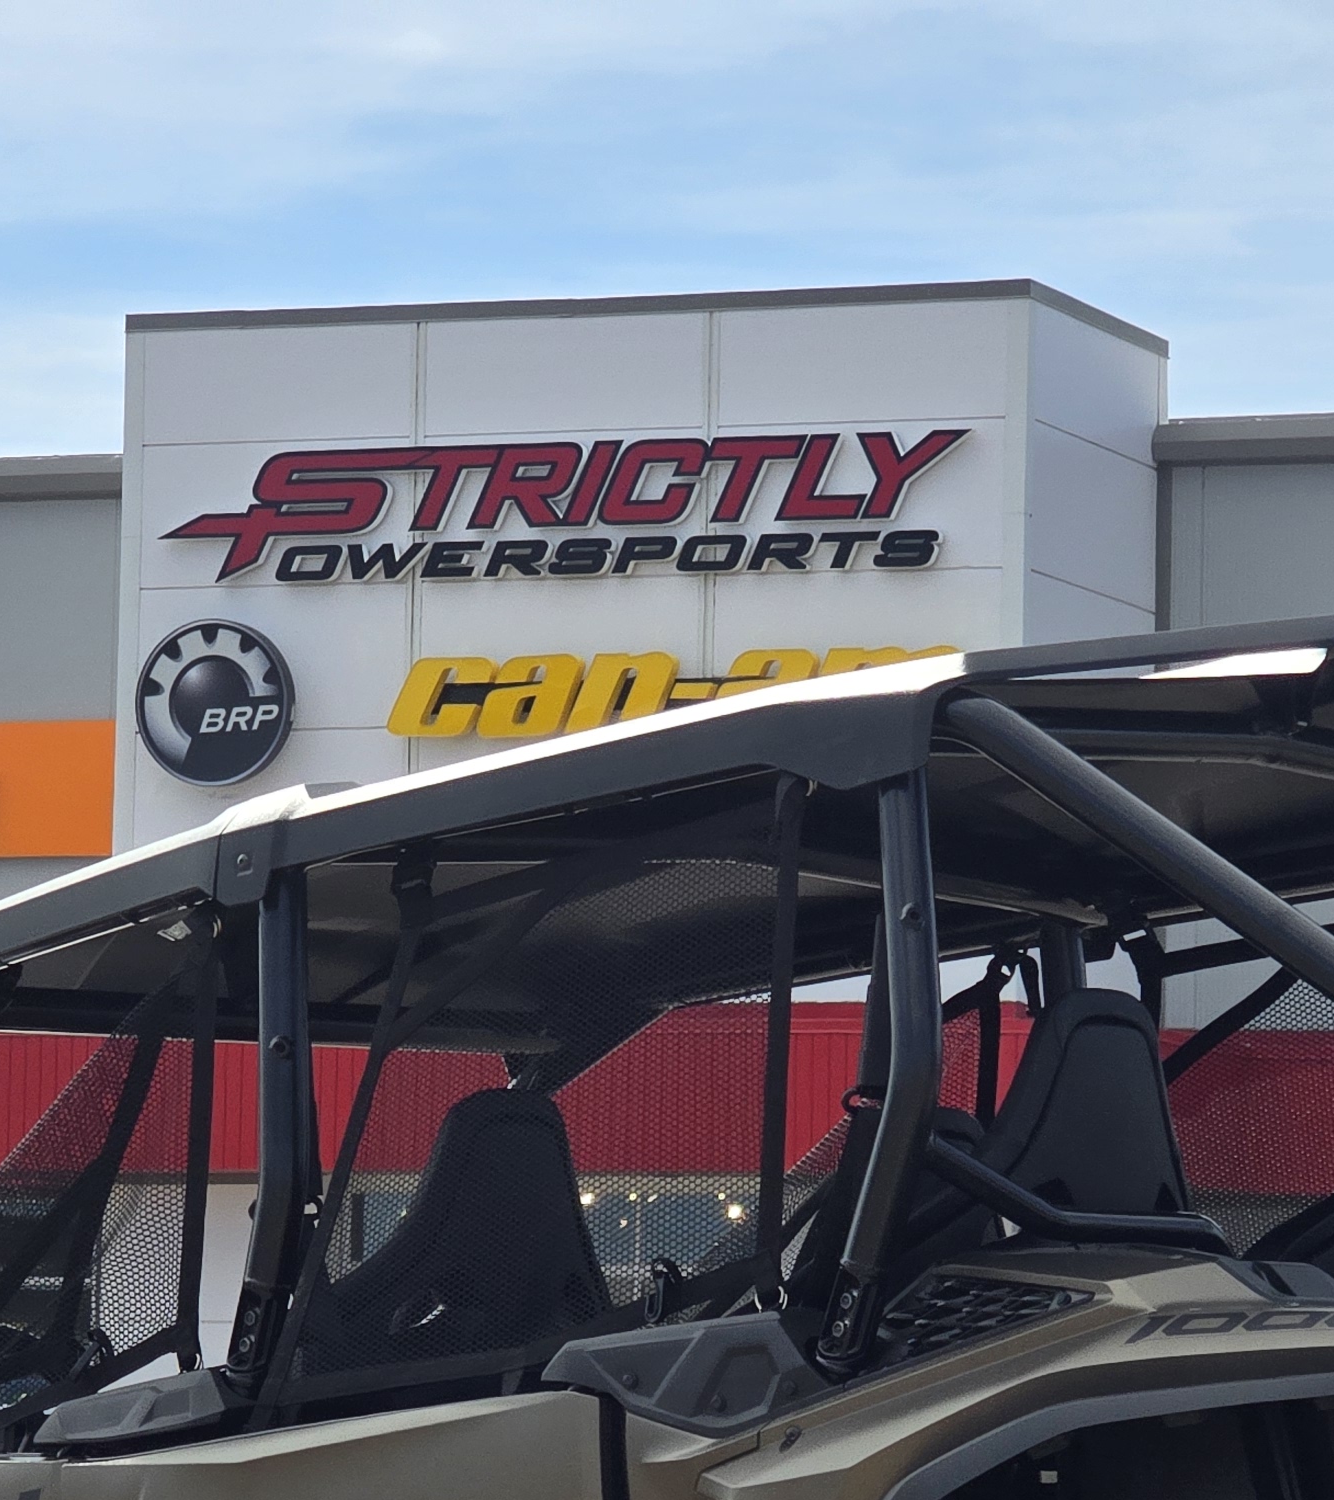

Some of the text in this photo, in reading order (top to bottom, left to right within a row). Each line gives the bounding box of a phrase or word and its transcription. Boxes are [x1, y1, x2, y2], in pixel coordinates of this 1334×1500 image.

[157, 429, 972, 542] STRICTLY
[199, 704, 280, 734] BRP
[386, 646, 962, 738] can-
